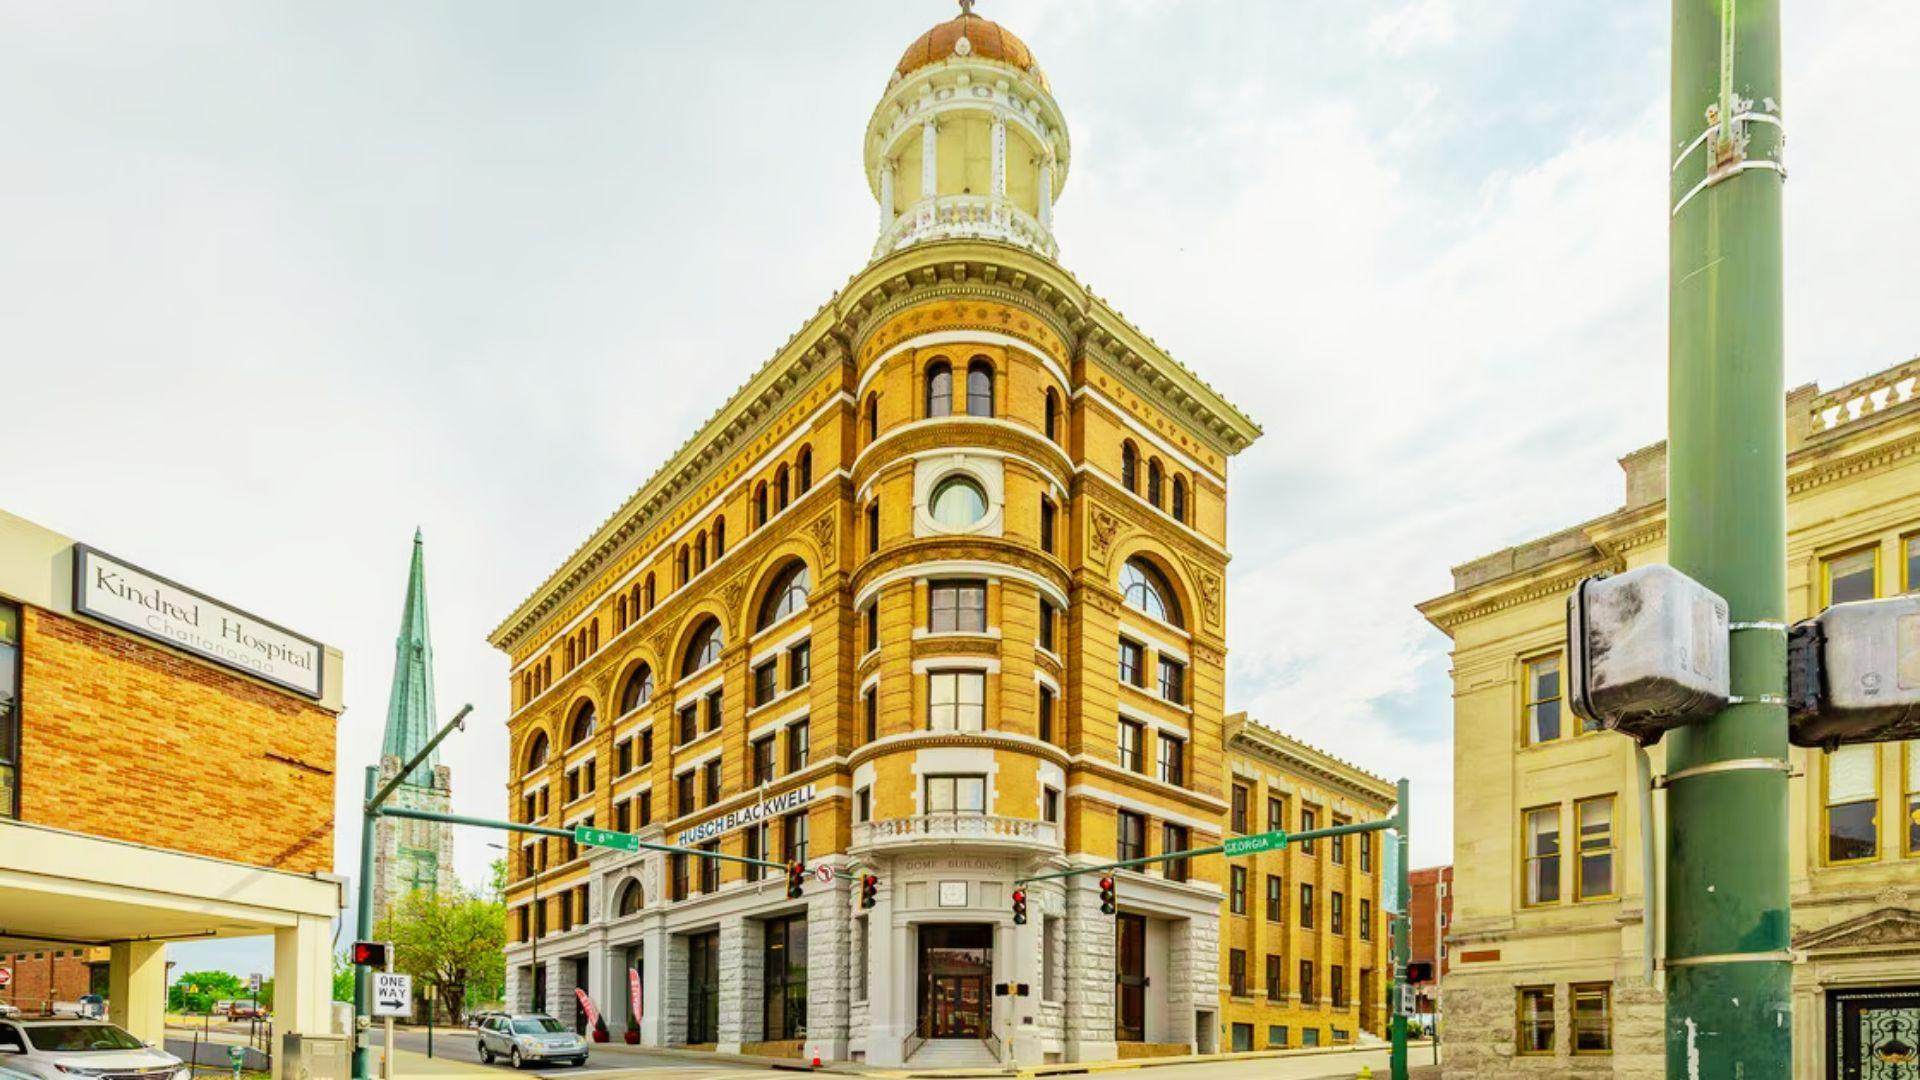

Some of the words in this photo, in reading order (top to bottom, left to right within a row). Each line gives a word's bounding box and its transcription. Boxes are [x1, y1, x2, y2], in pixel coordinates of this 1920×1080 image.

[96, 565, 199, 627] Kindred
[221, 616, 312, 672] Hospital
[146, 614, 274, 673] Chattanooga
[679, 818, 725, 846] HUSCH
[726, 784, 816, 830] BLACKWELL
[1224, 838, 1269, 854] GEORGIA
[379, 987, 406, 999] WAY
[380, 975, 406, 987] ONE
